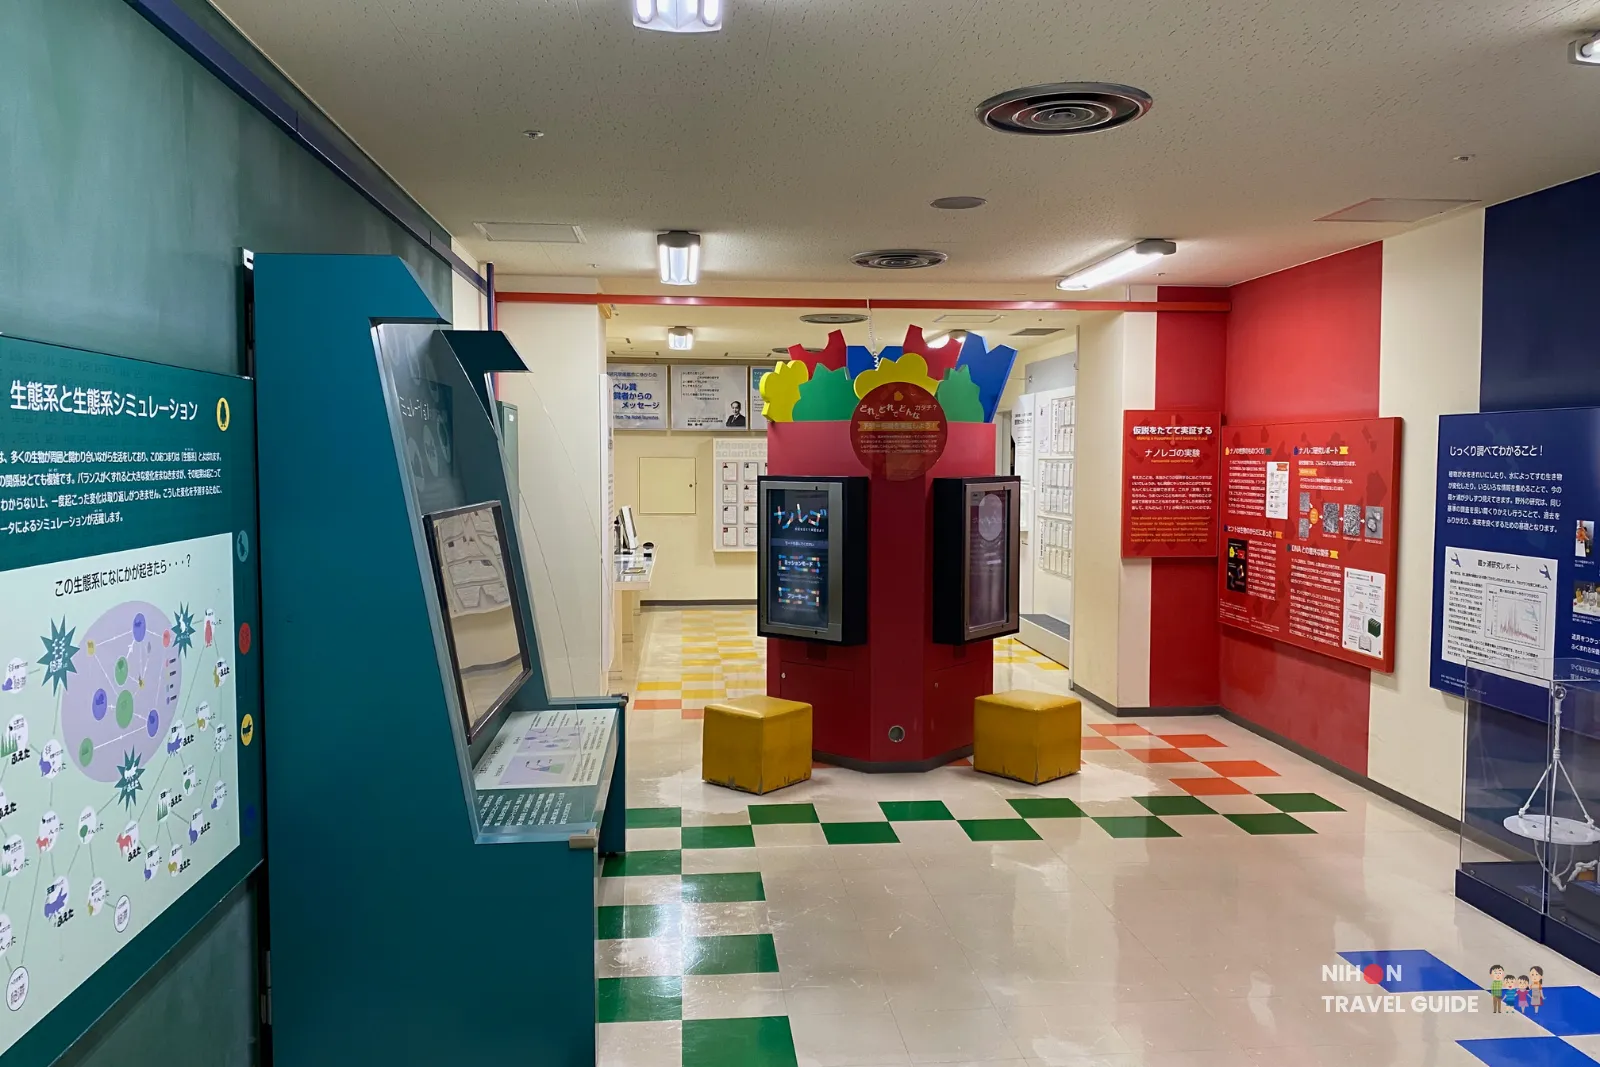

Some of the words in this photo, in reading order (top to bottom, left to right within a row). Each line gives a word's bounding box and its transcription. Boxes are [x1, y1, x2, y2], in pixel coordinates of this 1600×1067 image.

[10, 379, 198, 421] 生態系と生態系シミュレーション
[1132, 426, 1213, 435] 仮説をたてて実証する
[1145, 449, 1200, 458] ナノレゴの実験
[1449, 445, 1544, 457] じっくり調べてわかること！
[1477, 559, 1520, 572] 霞ヶ浦研究レポート
[1571, 633, 1600, 646] 道具をつかっ
[11, 748, 31, 765] ふえた
